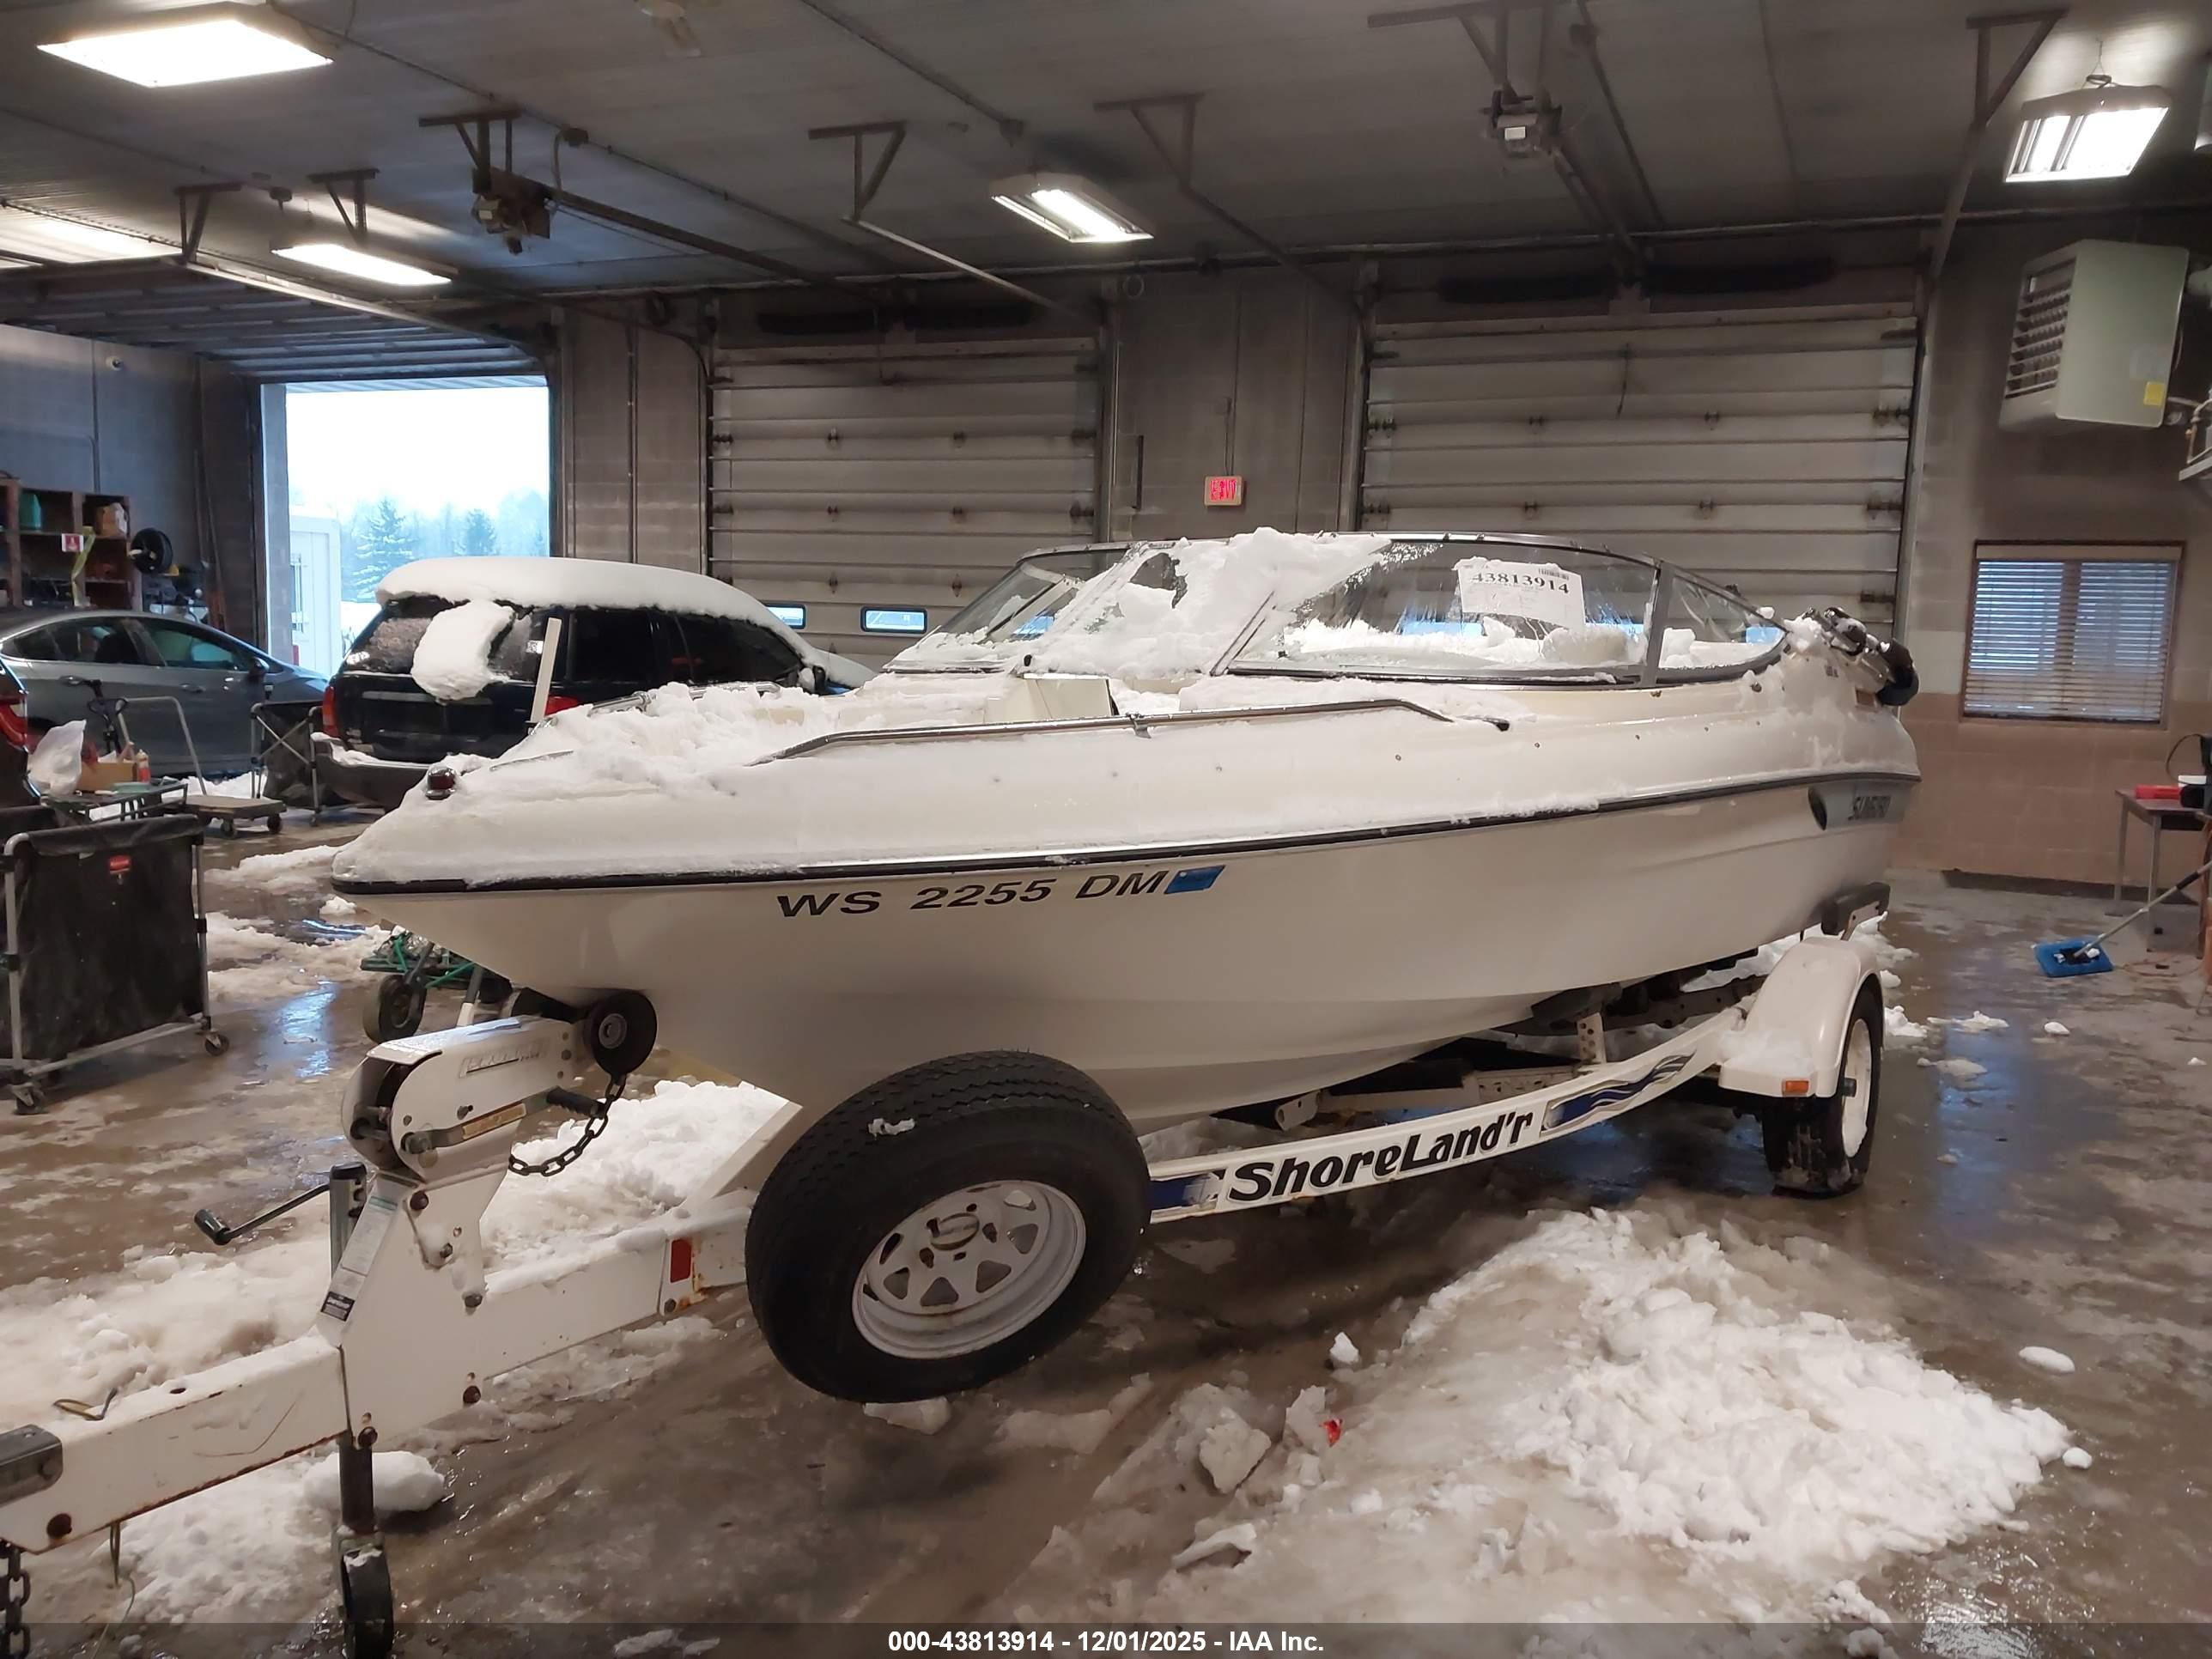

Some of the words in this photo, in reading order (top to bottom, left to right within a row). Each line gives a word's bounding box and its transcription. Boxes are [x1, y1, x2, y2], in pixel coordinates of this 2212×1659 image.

[1471, 572, 1570, 594] 43813914
[777, 890, 882, 917] WS
[909, 878, 1057, 910] 2255
[1075, 870, 1169, 899] DM
[1229, 1110, 1534, 1202] ShoreLand'r
